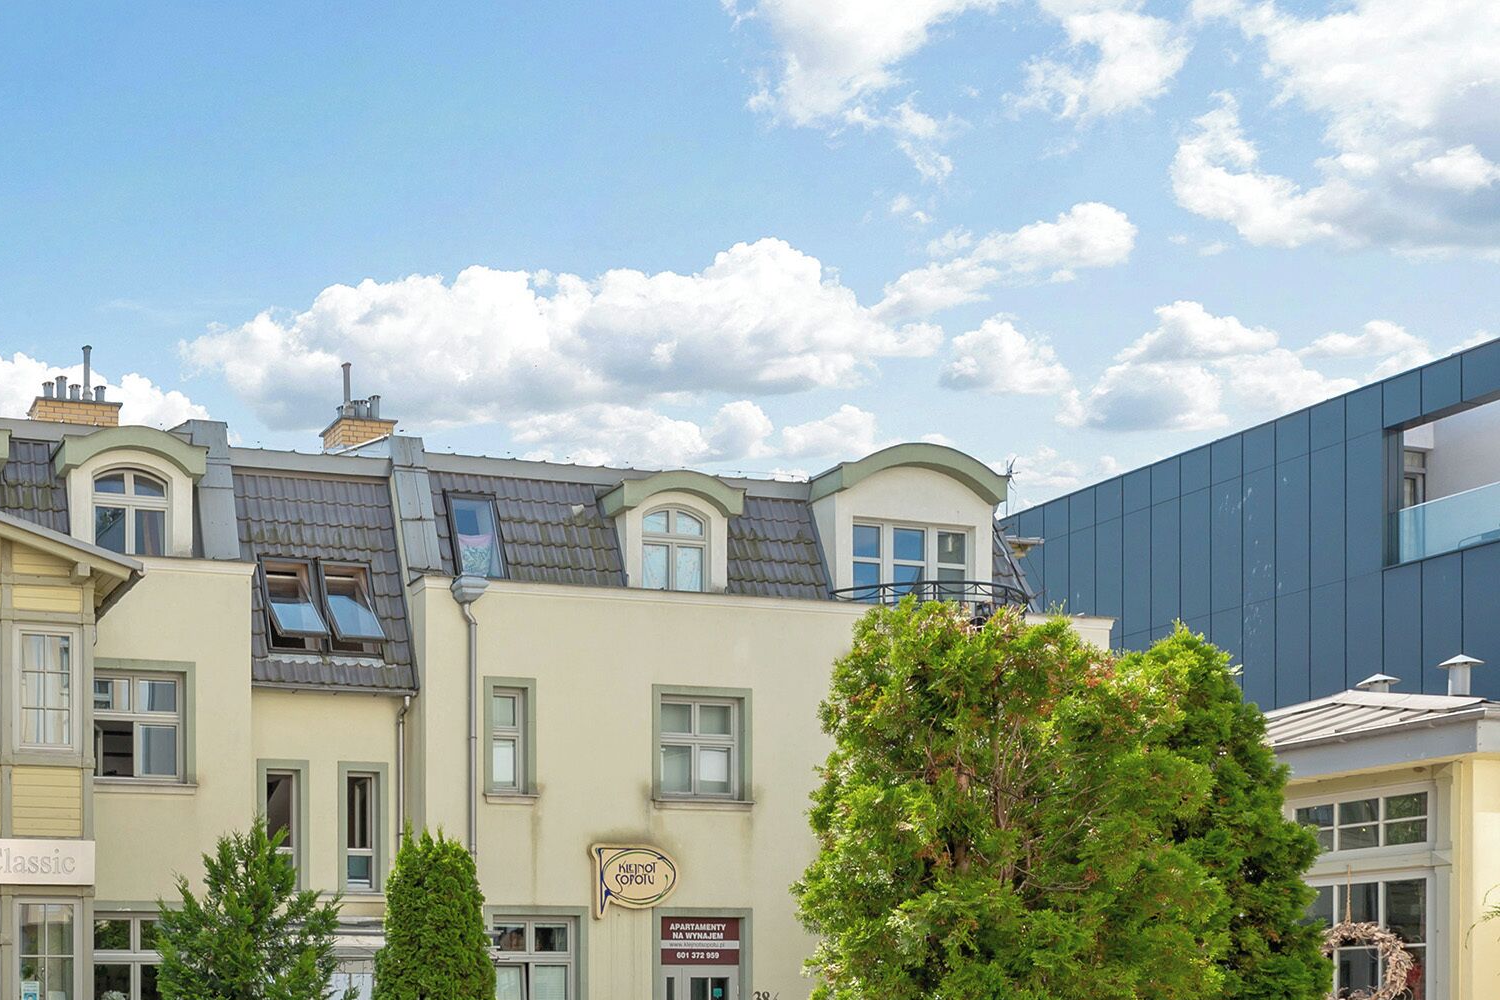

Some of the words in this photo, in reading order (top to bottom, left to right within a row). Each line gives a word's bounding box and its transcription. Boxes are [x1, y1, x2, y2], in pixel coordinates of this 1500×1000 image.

[618, 860, 658, 876] KLEJNOT
[615, 873, 655, 893] SOPOTU
[669, 923, 727, 931] APARTAMENTY
[685, 932, 724, 940] WYNAJEM
